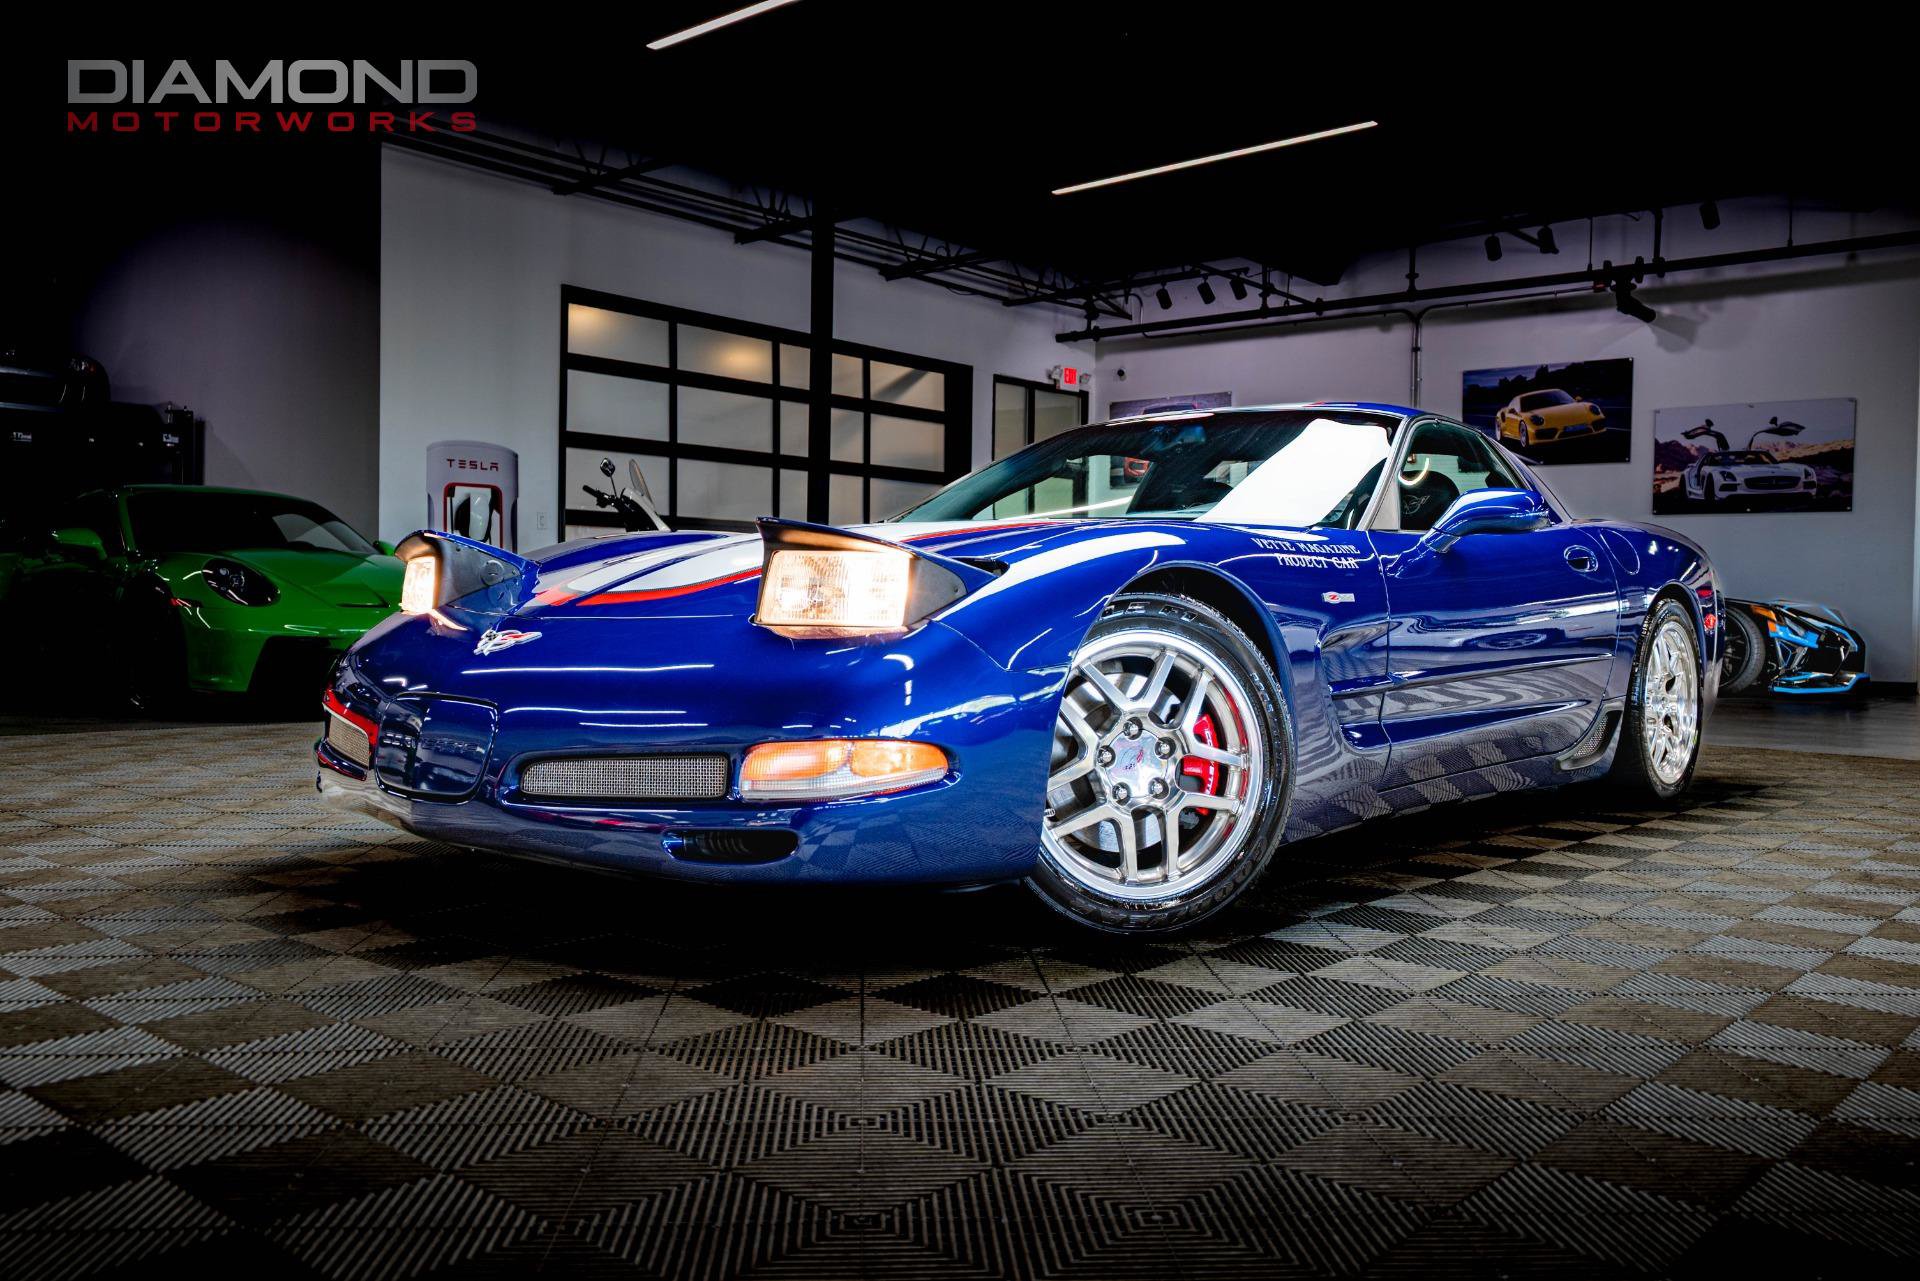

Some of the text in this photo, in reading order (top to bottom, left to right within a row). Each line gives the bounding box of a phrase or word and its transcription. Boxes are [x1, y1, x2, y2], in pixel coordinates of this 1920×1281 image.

[446, 458, 499, 472] TESLA
[1251, 537, 1360, 555] VETTE MAGAZINE
[1275, 554, 1359, 569] PROJECT CAR
[1204, 728, 1215, 796] COETTE
